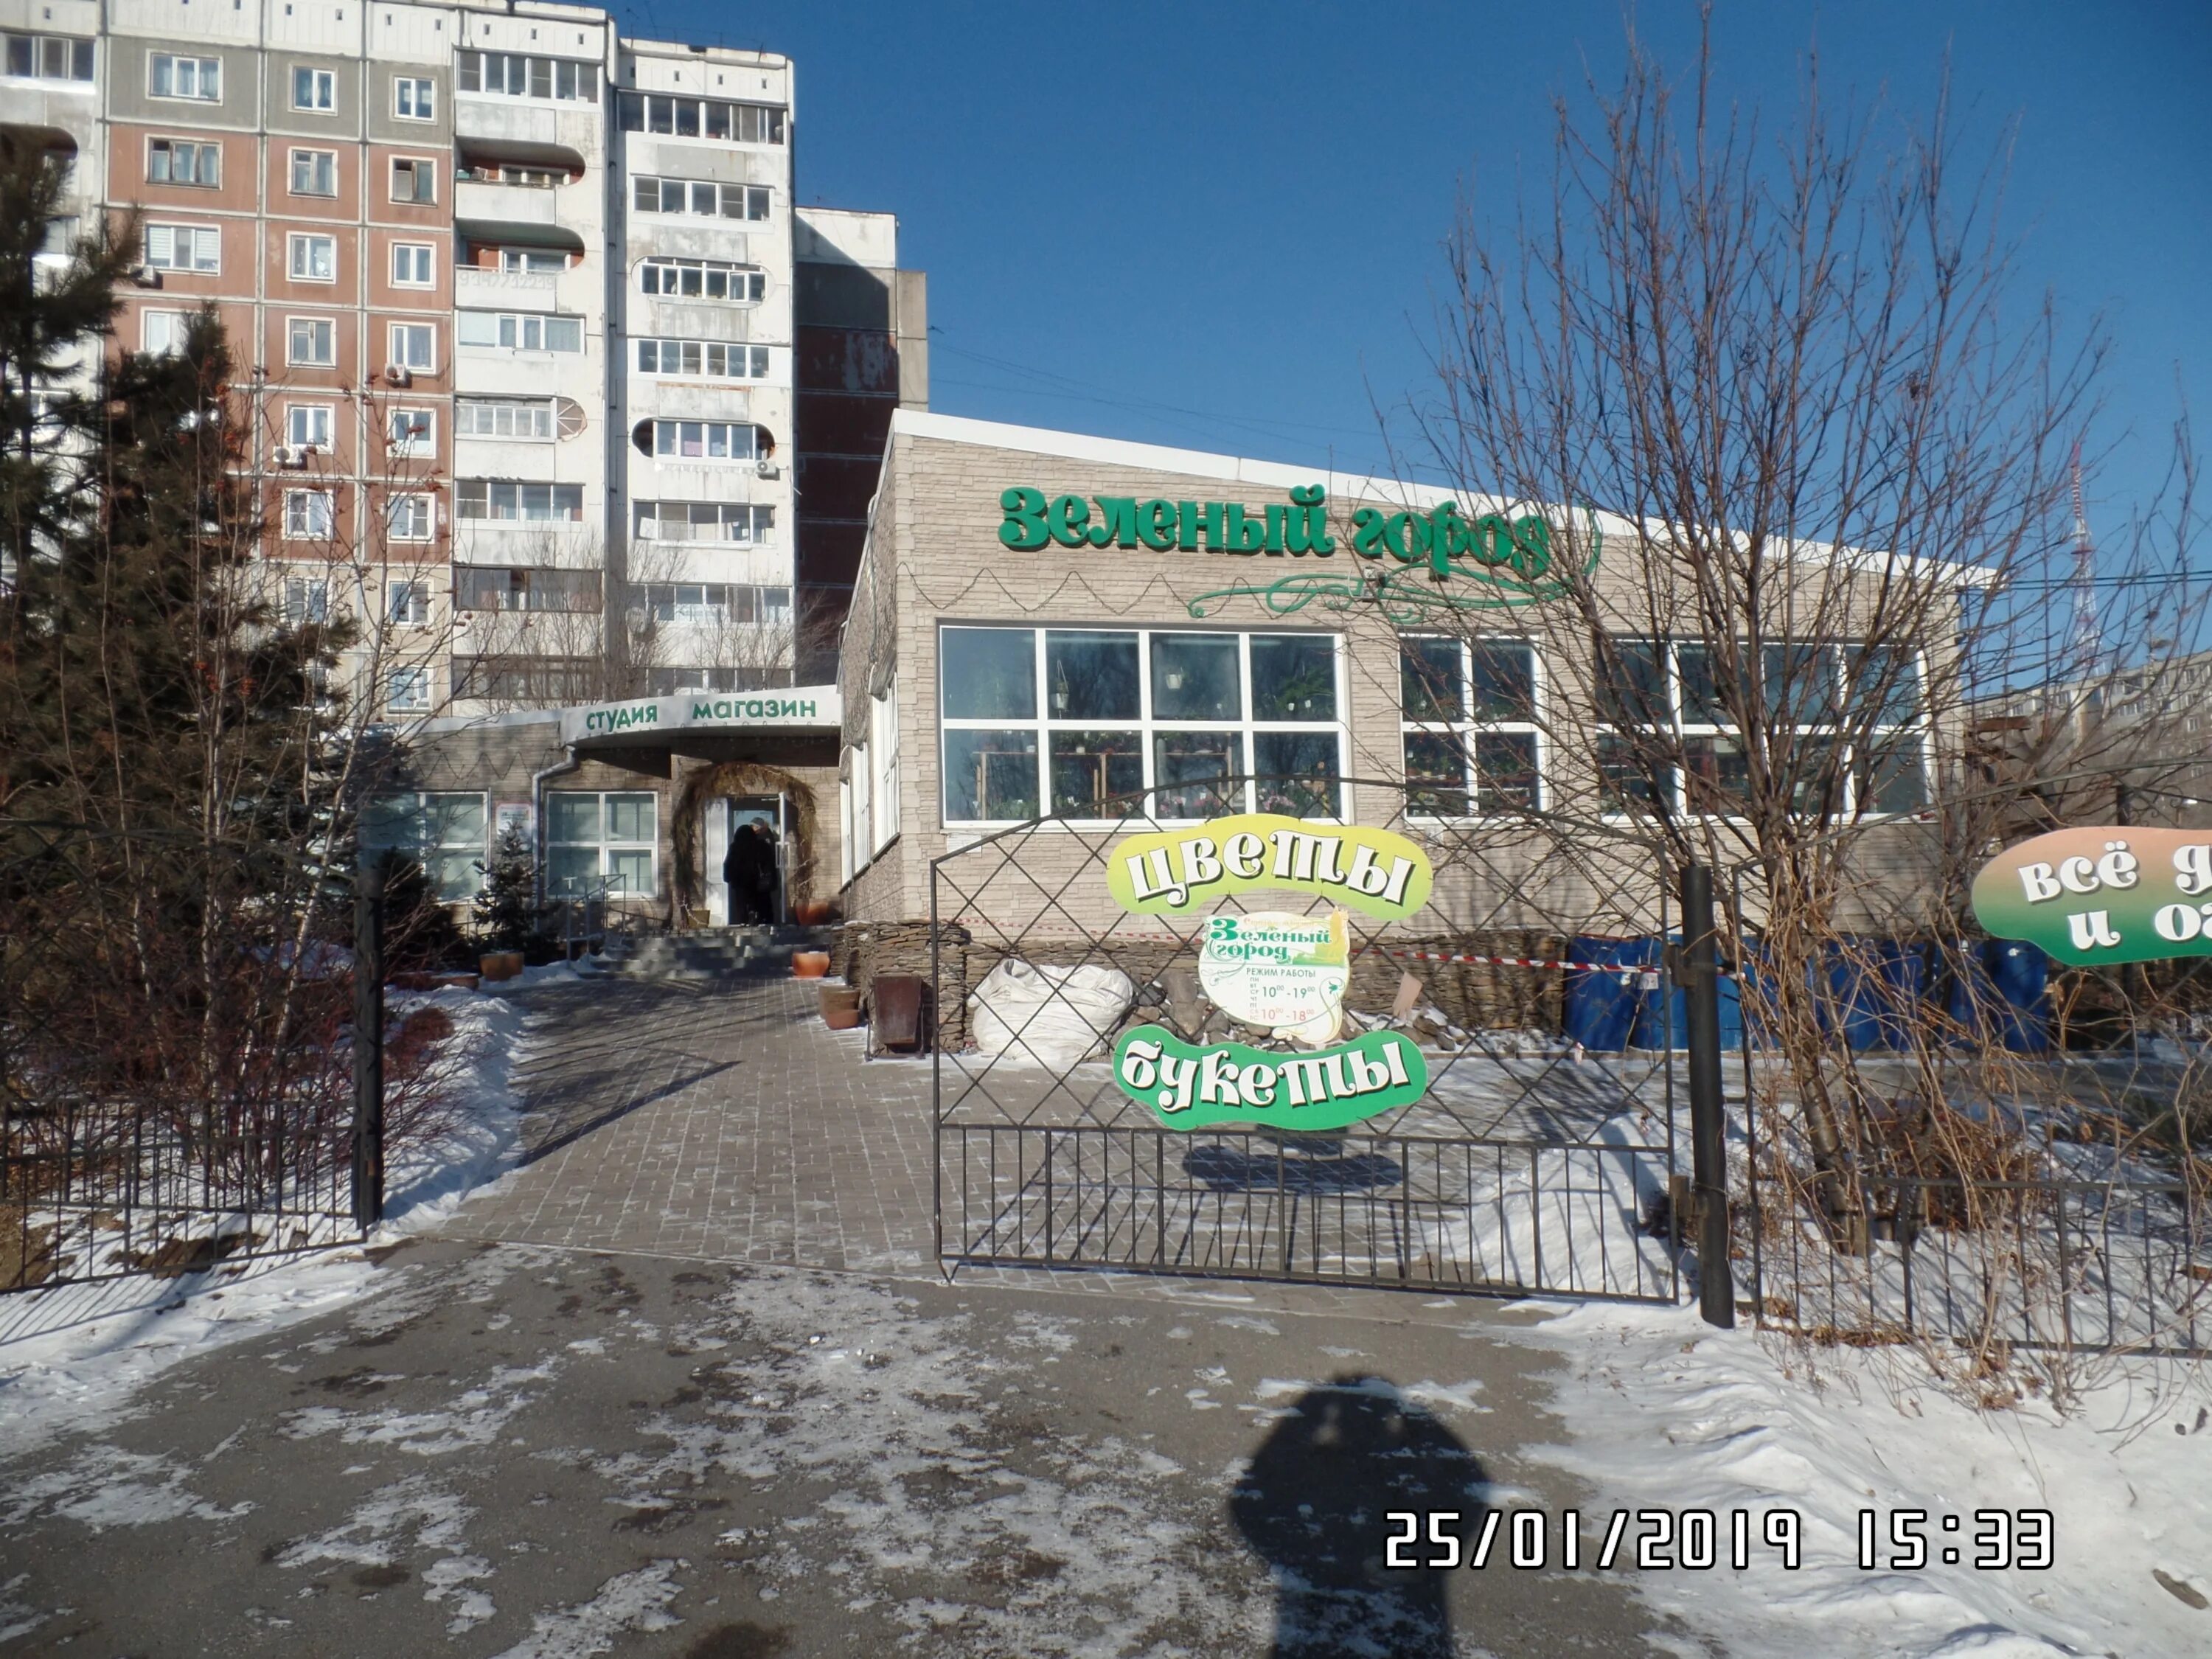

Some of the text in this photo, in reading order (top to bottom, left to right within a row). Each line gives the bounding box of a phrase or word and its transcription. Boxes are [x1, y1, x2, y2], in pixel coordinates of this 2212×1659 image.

[999, 484, 1551, 582] Зеленый город
[2017, 840, 2138, 902] всё
[2067, 902, 2212, 950] и о
[1217, 942, 1290, 964] город
[1246, 967, 1316, 978] РЕЖИМ РАБОТЫ
